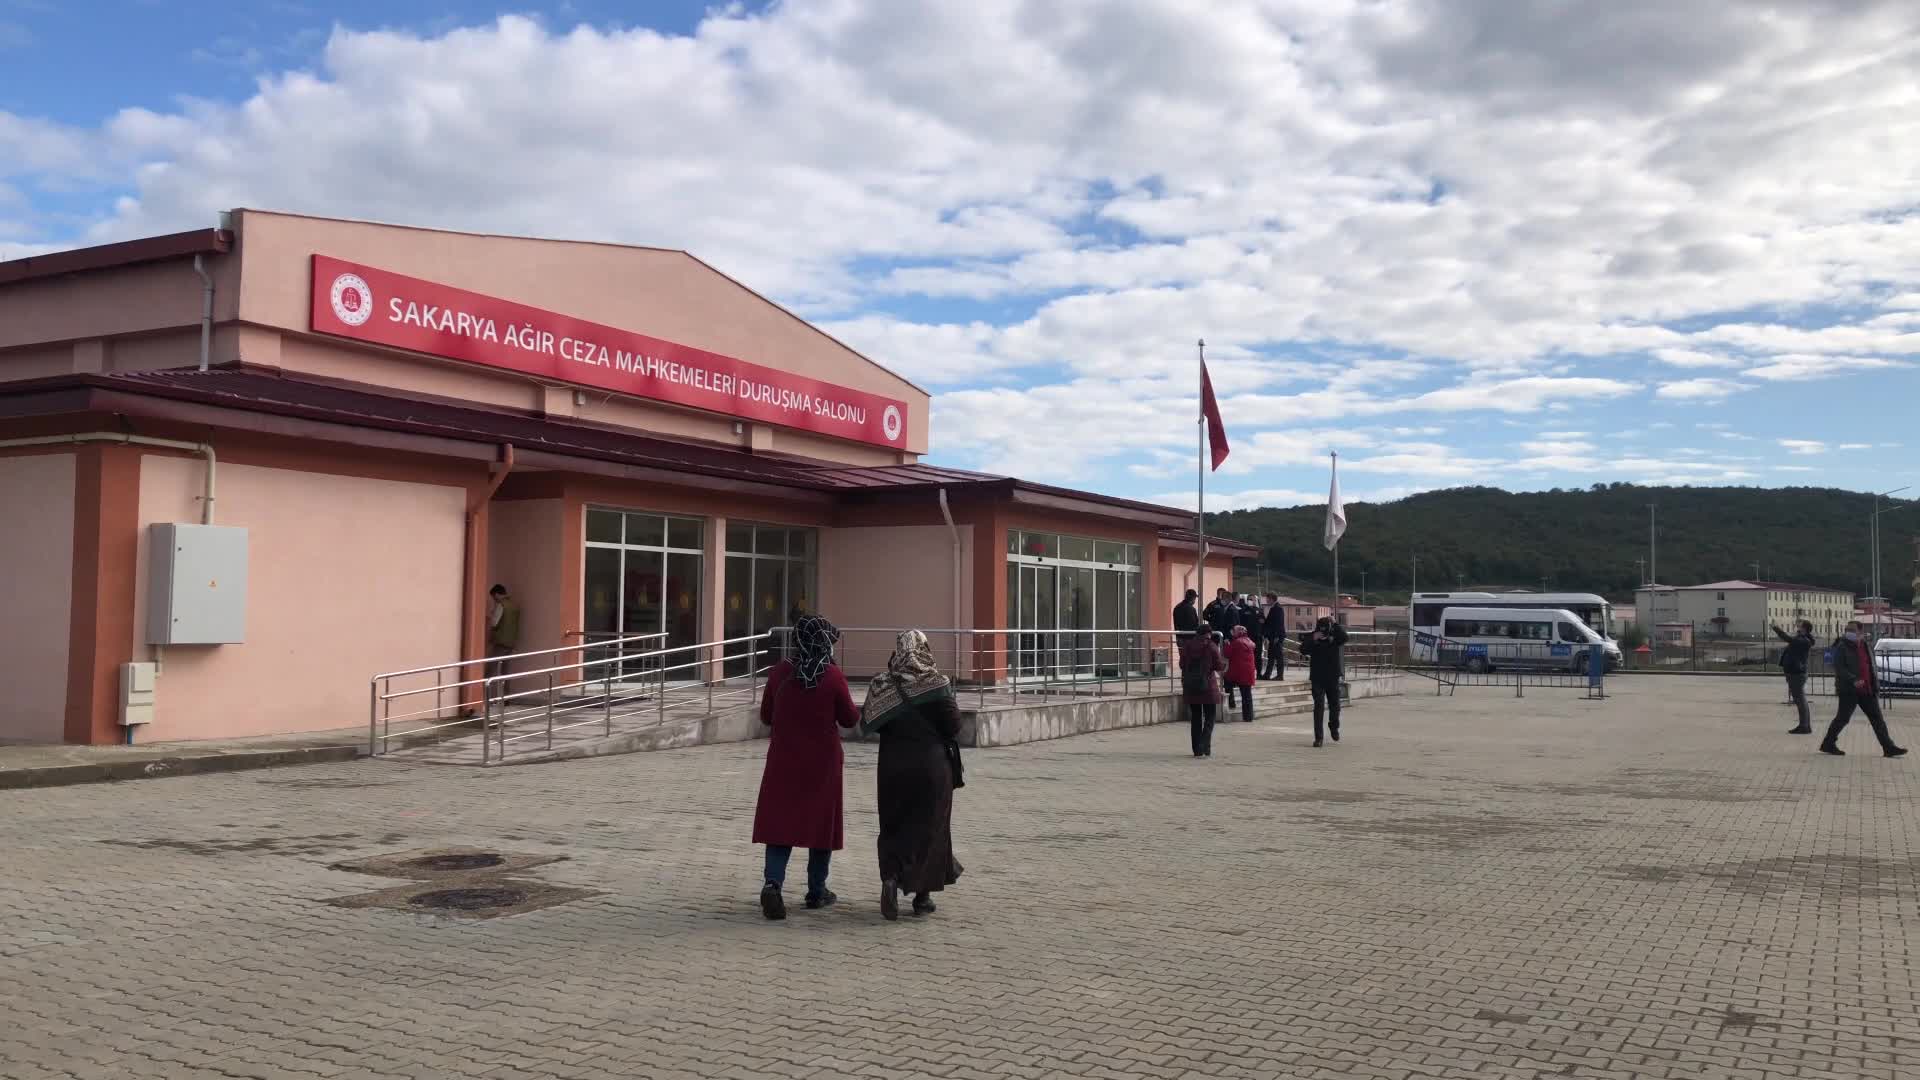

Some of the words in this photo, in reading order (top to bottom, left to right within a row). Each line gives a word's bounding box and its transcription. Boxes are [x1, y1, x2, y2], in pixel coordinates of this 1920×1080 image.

[389, 297, 498, 343] SAKARYA
[504, 323, 555, 355] AĞIR
[559, 337, 610, 368] CEZA
[616, 350, 736, 395] MAHKEMELERİ
[740, 379, 812, 412] DURUŞMA
[815, 397, 866, 425] SALONU
